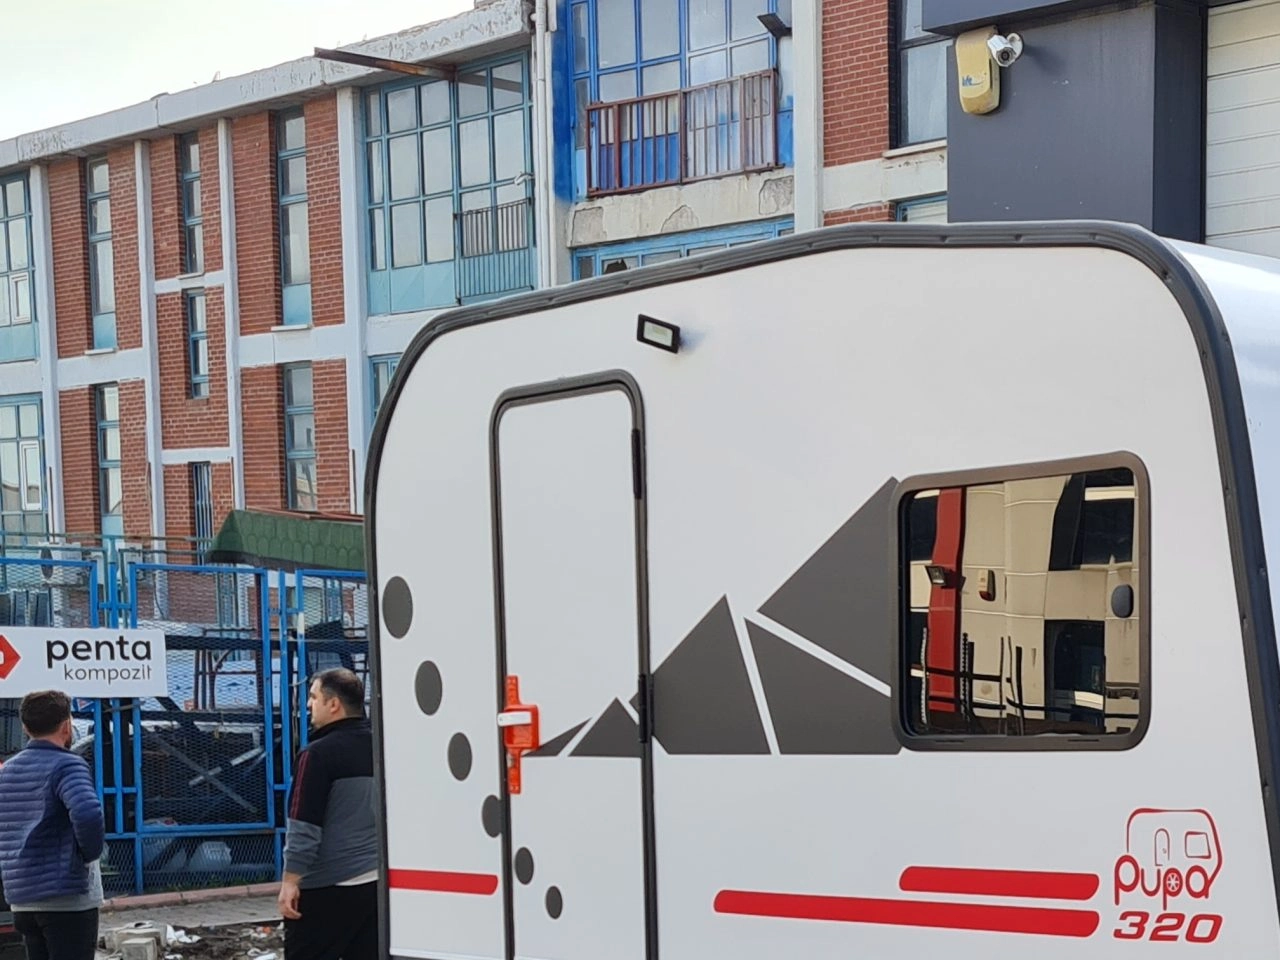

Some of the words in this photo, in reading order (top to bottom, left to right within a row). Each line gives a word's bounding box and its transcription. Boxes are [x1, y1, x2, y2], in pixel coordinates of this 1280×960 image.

[46, 636, 152, 669] penta
[64, 664, 152, 685] kompozit
[1114, 854, 1211, 911] pupa
[1113, 910, 1224, 944] 320
